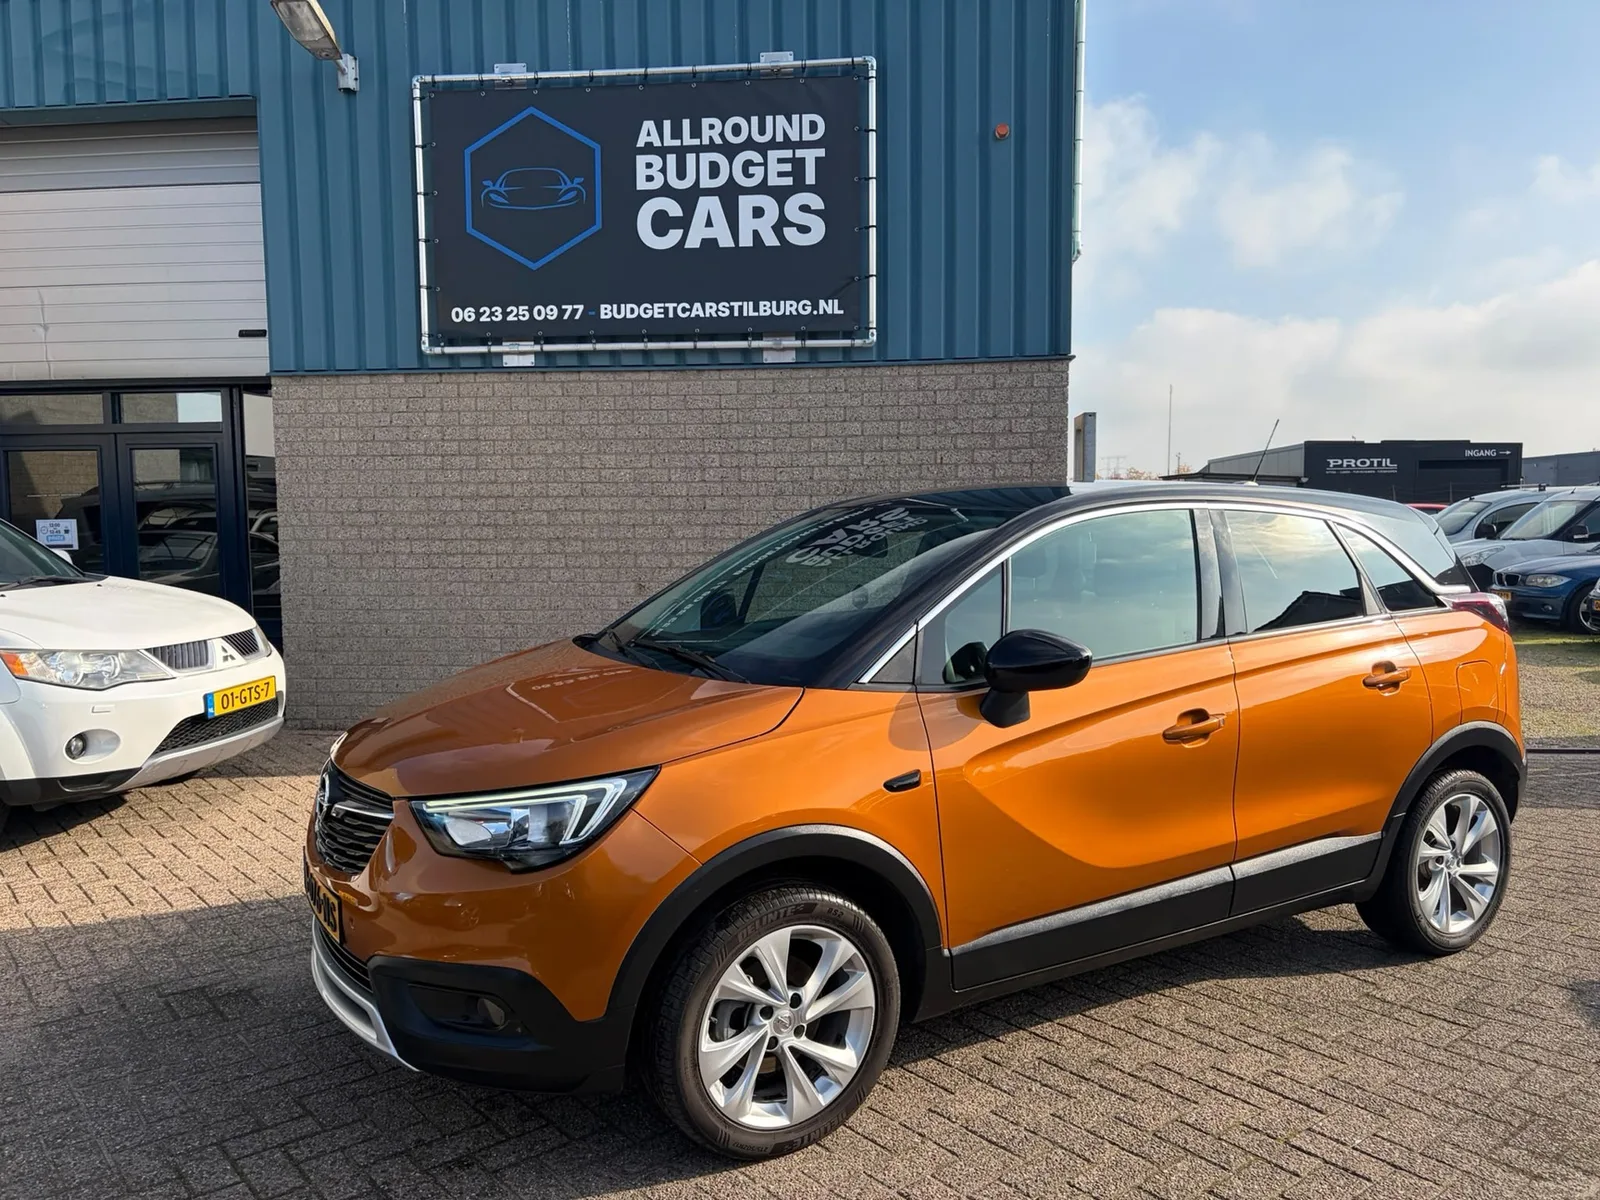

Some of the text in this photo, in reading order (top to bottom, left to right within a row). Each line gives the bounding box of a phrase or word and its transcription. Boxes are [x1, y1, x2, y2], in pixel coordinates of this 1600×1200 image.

[636, 113, 825, 148] ALLROUND
[636, 148, 825, 191] BUDGET
[636, 192, 826, 250] CARS
[451, 306, 476, 323] 06
[479, 305, 504, 322] 23
[506, 305, 531, 322] 25
[533, 305, 558, 321] 09
[561, 304, 584, 321] 77
[600, 299, 844, 320] BUDGETCARSTILBURG.NL
[1326, 458, 1398, 467] PROTIL
[1464, 449, 1497, 457] INGANG
[221, 681, 270, 710] 01-GTS-7
